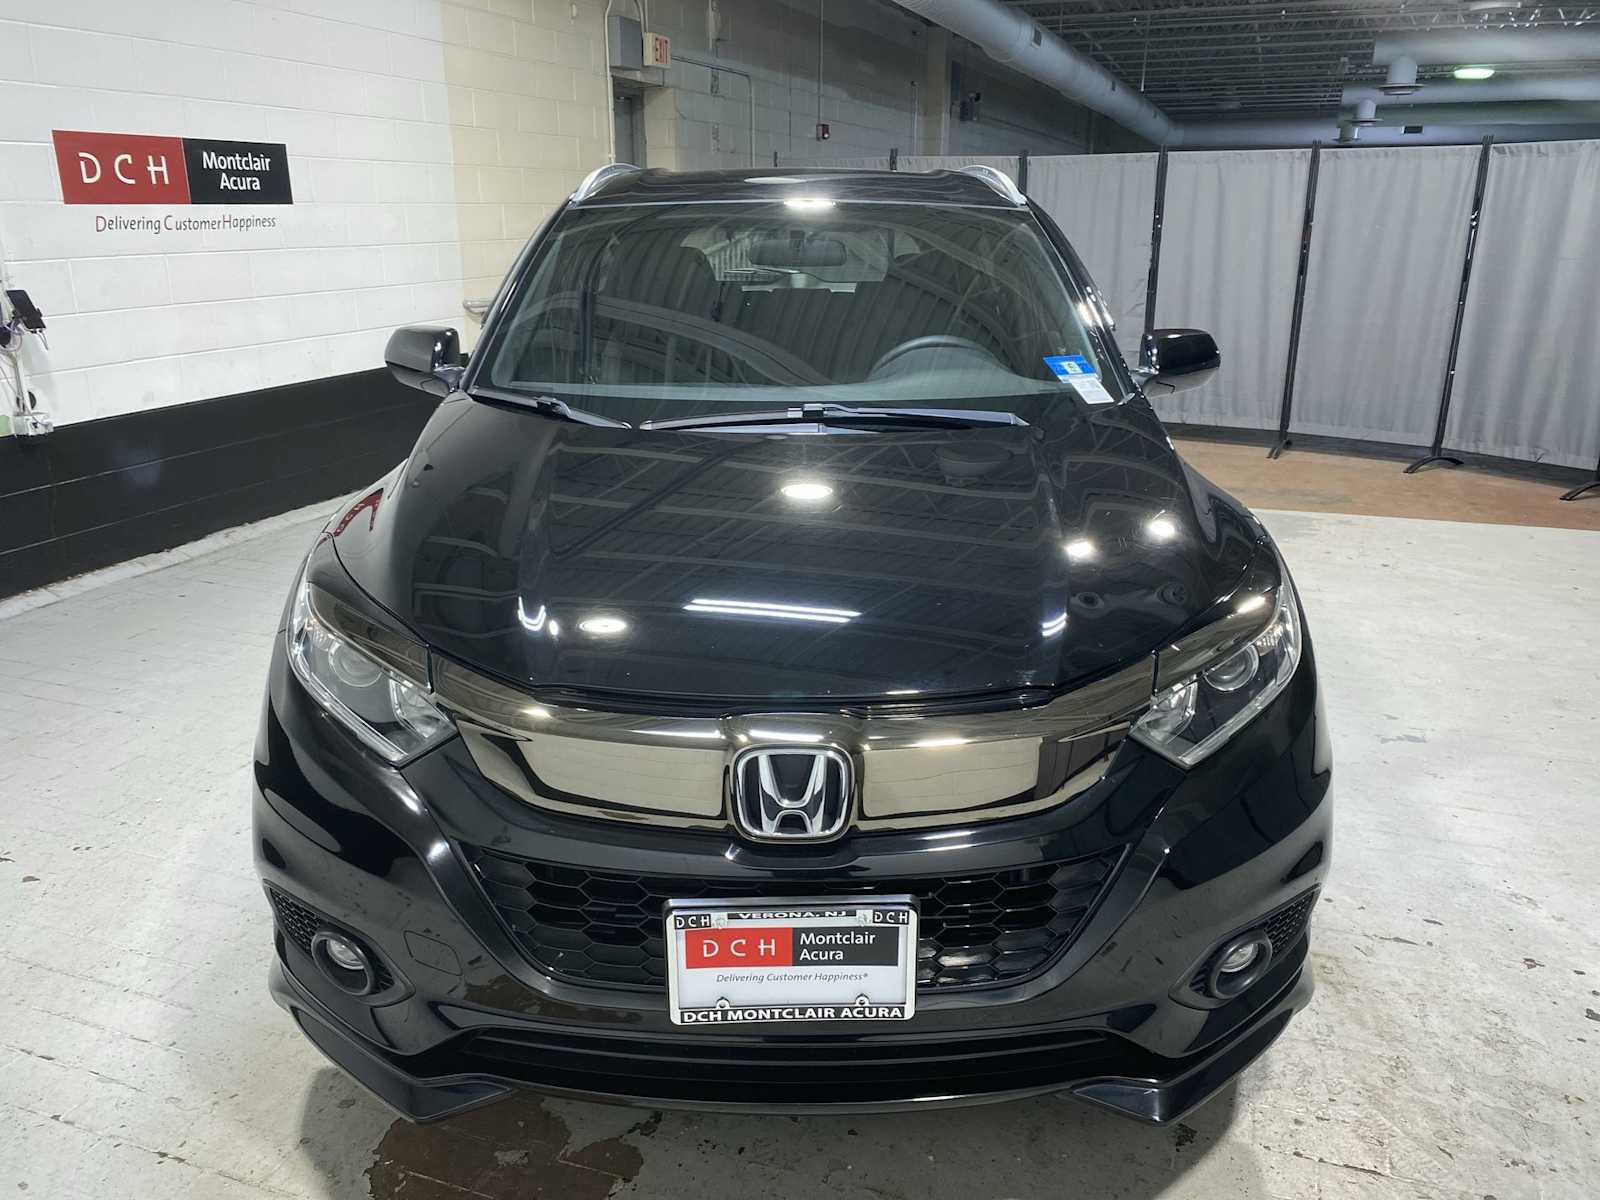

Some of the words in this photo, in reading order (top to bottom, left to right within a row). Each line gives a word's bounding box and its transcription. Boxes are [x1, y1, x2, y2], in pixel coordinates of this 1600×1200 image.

[202, 151, 271, 171] Montclair
[219, 172, 261, 191] Acura
[95, 215, 161, 234] Delivering
[222, 214, 276, 232] Happiness
[676, 914, 710, 928] DCH
[873, 911, 908, 924] DCH
[799, 931, 876, 945] Montclair
[799, 948, 844, 960] Acura
[716, 973, 764, 983] Delivering
[766, 972, 812, 981] Customer
[683, 1011, 722, 1023] DCH
[727, 1007, 836, 1021] MONTCLAIR
[840, 1007, 903, 1018] ACURA
